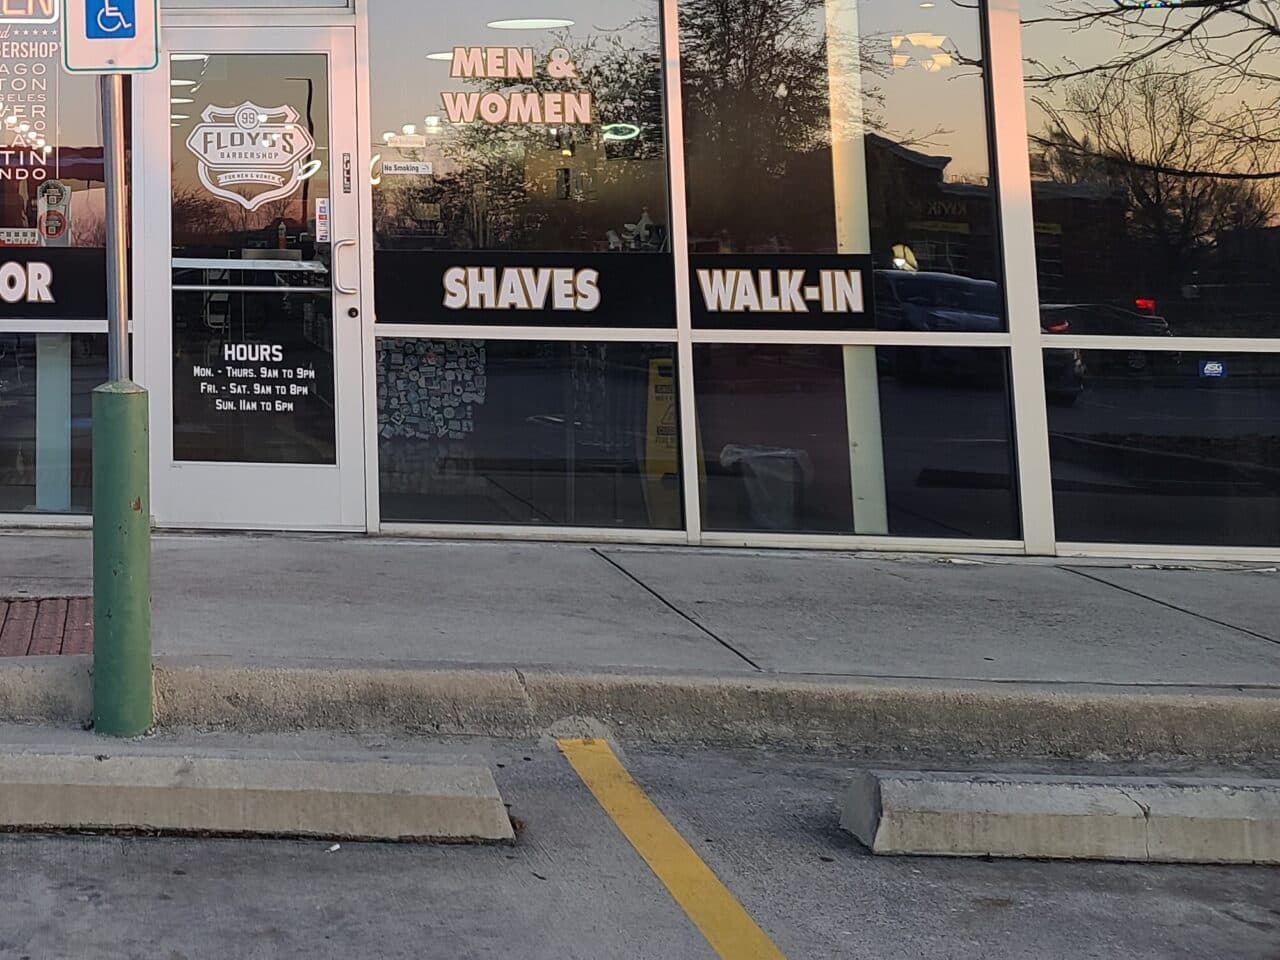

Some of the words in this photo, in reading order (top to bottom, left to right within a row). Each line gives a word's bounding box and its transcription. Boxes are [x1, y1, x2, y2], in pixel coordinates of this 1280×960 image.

[450, 46, 534, 78] MEN
[547, 46, 578, 79] &
[241, 112, 255, 124] 99
[440, 91, 593, 124] WOMEN
[203, 131, 294, 155] FLOYDS
[220, 151, 279, 159] BARBERSHOP
[384, 163, 393, 171] No
[394, 163, 419, 173] Smoking
[442, 265, 601, 311] SHAVES
[696, 267, 865, 313] WALK-IN
[224, 343, 283, 362] HOURS
